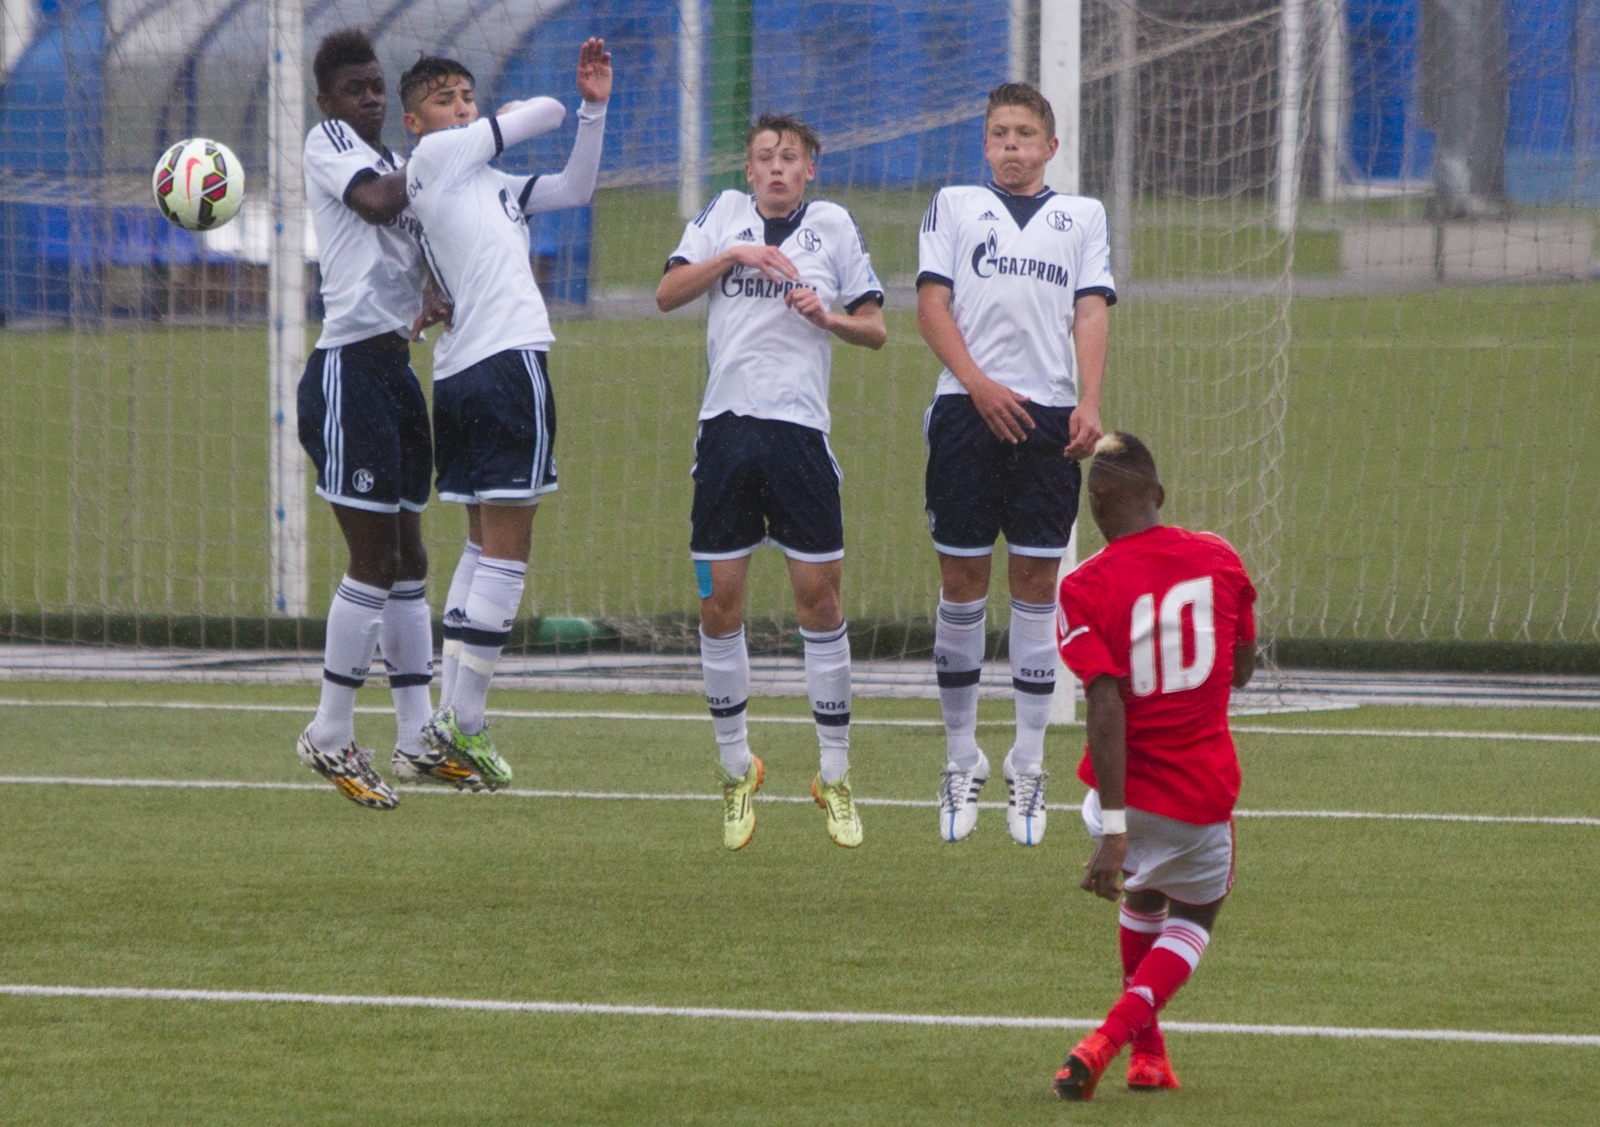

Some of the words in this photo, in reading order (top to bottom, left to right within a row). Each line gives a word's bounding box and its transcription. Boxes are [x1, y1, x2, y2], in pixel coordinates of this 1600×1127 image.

[999, 256, 1069, 288] GAZPROM
[744, 277, 817, 299] GAZPR
[1130, 575, 1216, 697] 10
[1020, 667, 1055, 678] S04
[815, 700, 847, 711] S04
